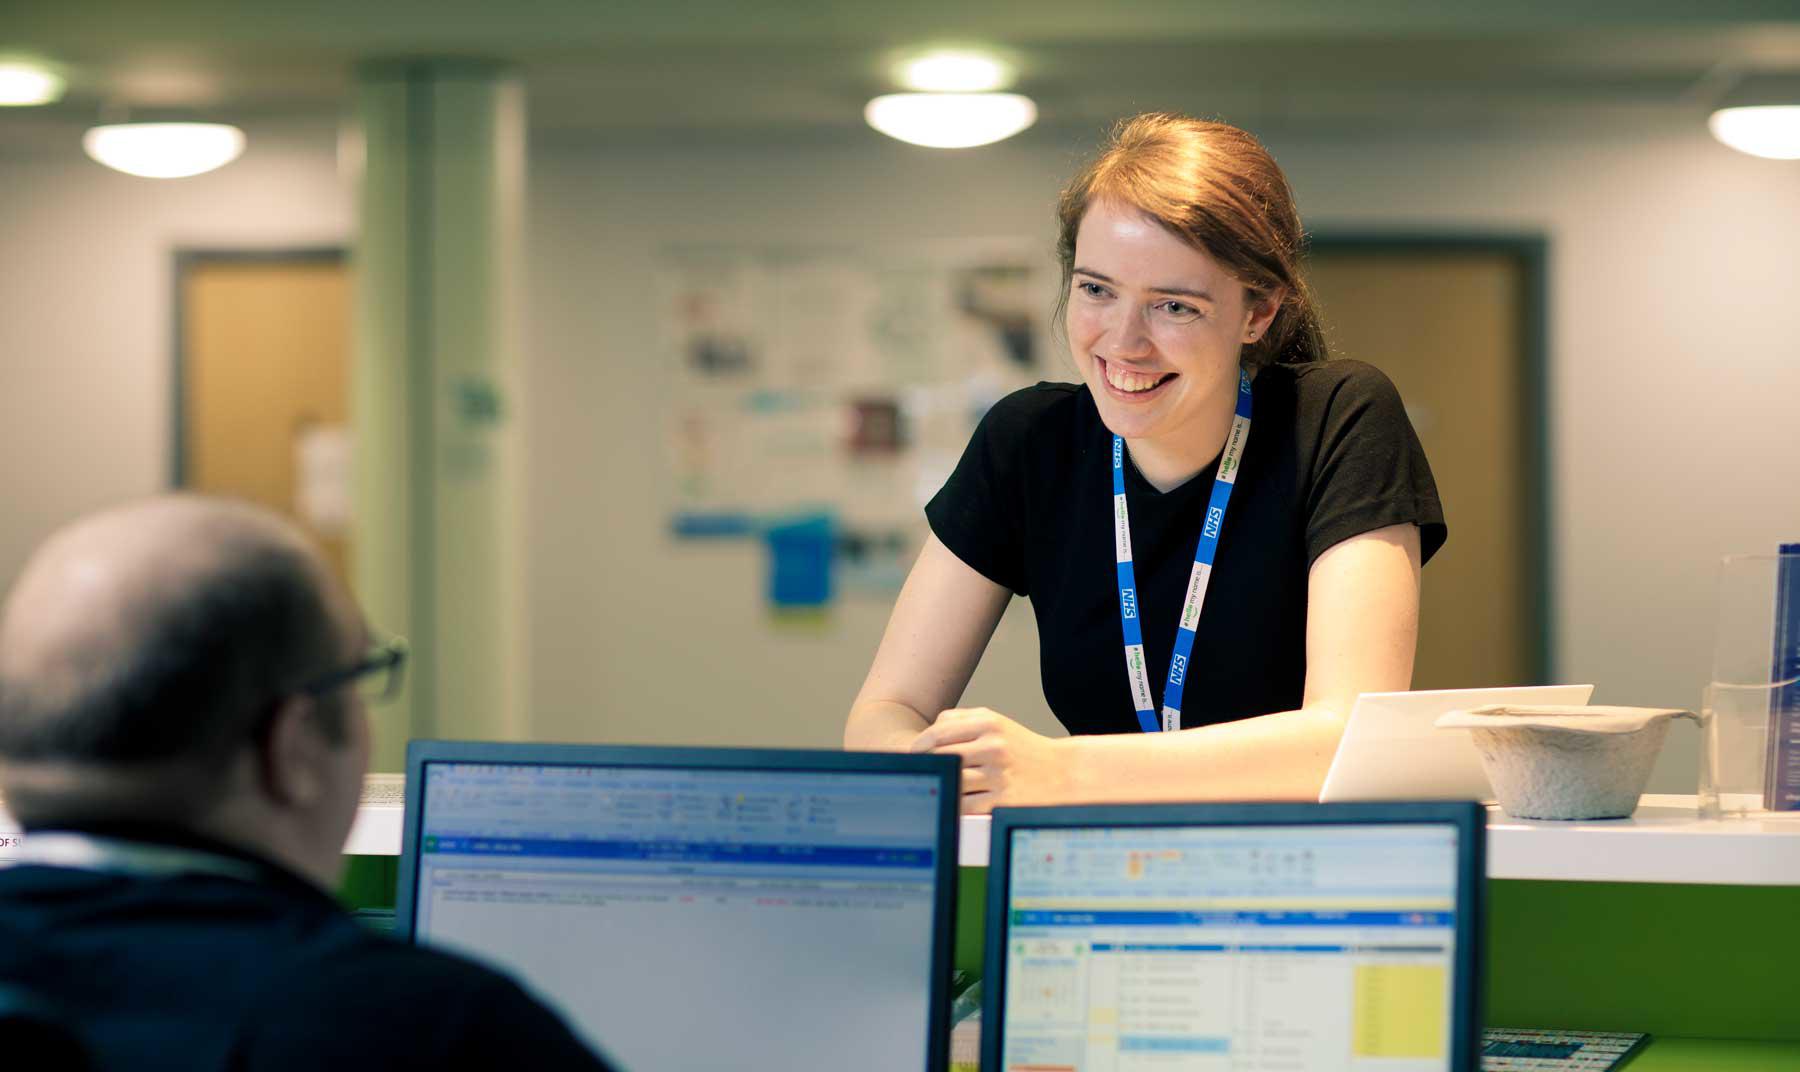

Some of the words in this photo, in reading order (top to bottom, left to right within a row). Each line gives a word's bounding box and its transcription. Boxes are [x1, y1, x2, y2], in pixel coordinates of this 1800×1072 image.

[1232, 429, 1240, 446] name
[1229, 446, 1237, 456] my
[1204, 508, 1221, 537] NHS
[1192, 576, 1200, 593] name
[1123, 590, 1135, 617] NHS
[1190, 593, 1198, 604] my
[1136, 670, 1142, 680] my
[1170, 655, 1186, 685] NHS
